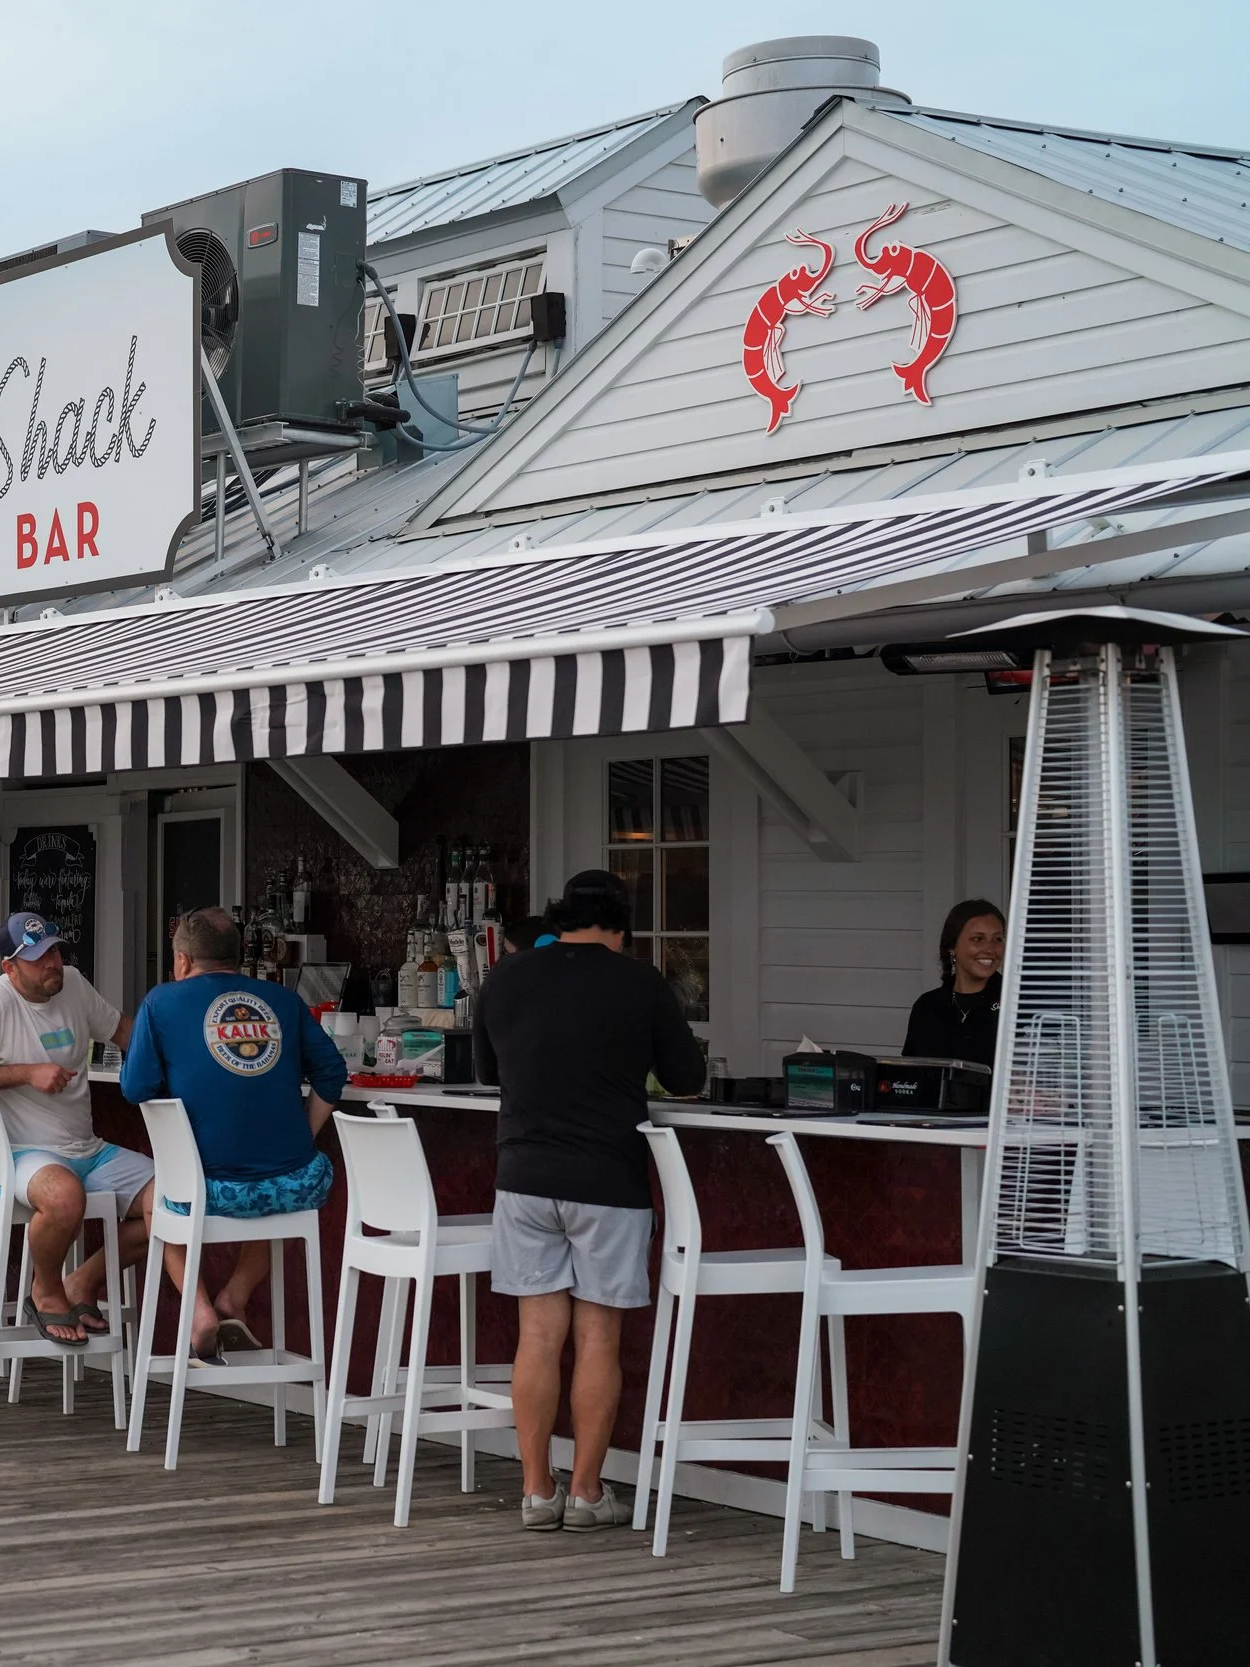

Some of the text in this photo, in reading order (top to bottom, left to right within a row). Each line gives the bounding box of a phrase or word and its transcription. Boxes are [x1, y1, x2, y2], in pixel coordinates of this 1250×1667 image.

[16, 501, 100, 569] BAR
[36, 834, 67, 851] DRINKS
[212, 996, 272, 1024] EXPORT QUALITY BEER
[217, 1024, 271, 1040] KALIK
[217, 1042, 276, 1070] BEER OF THE BAHAMAS
